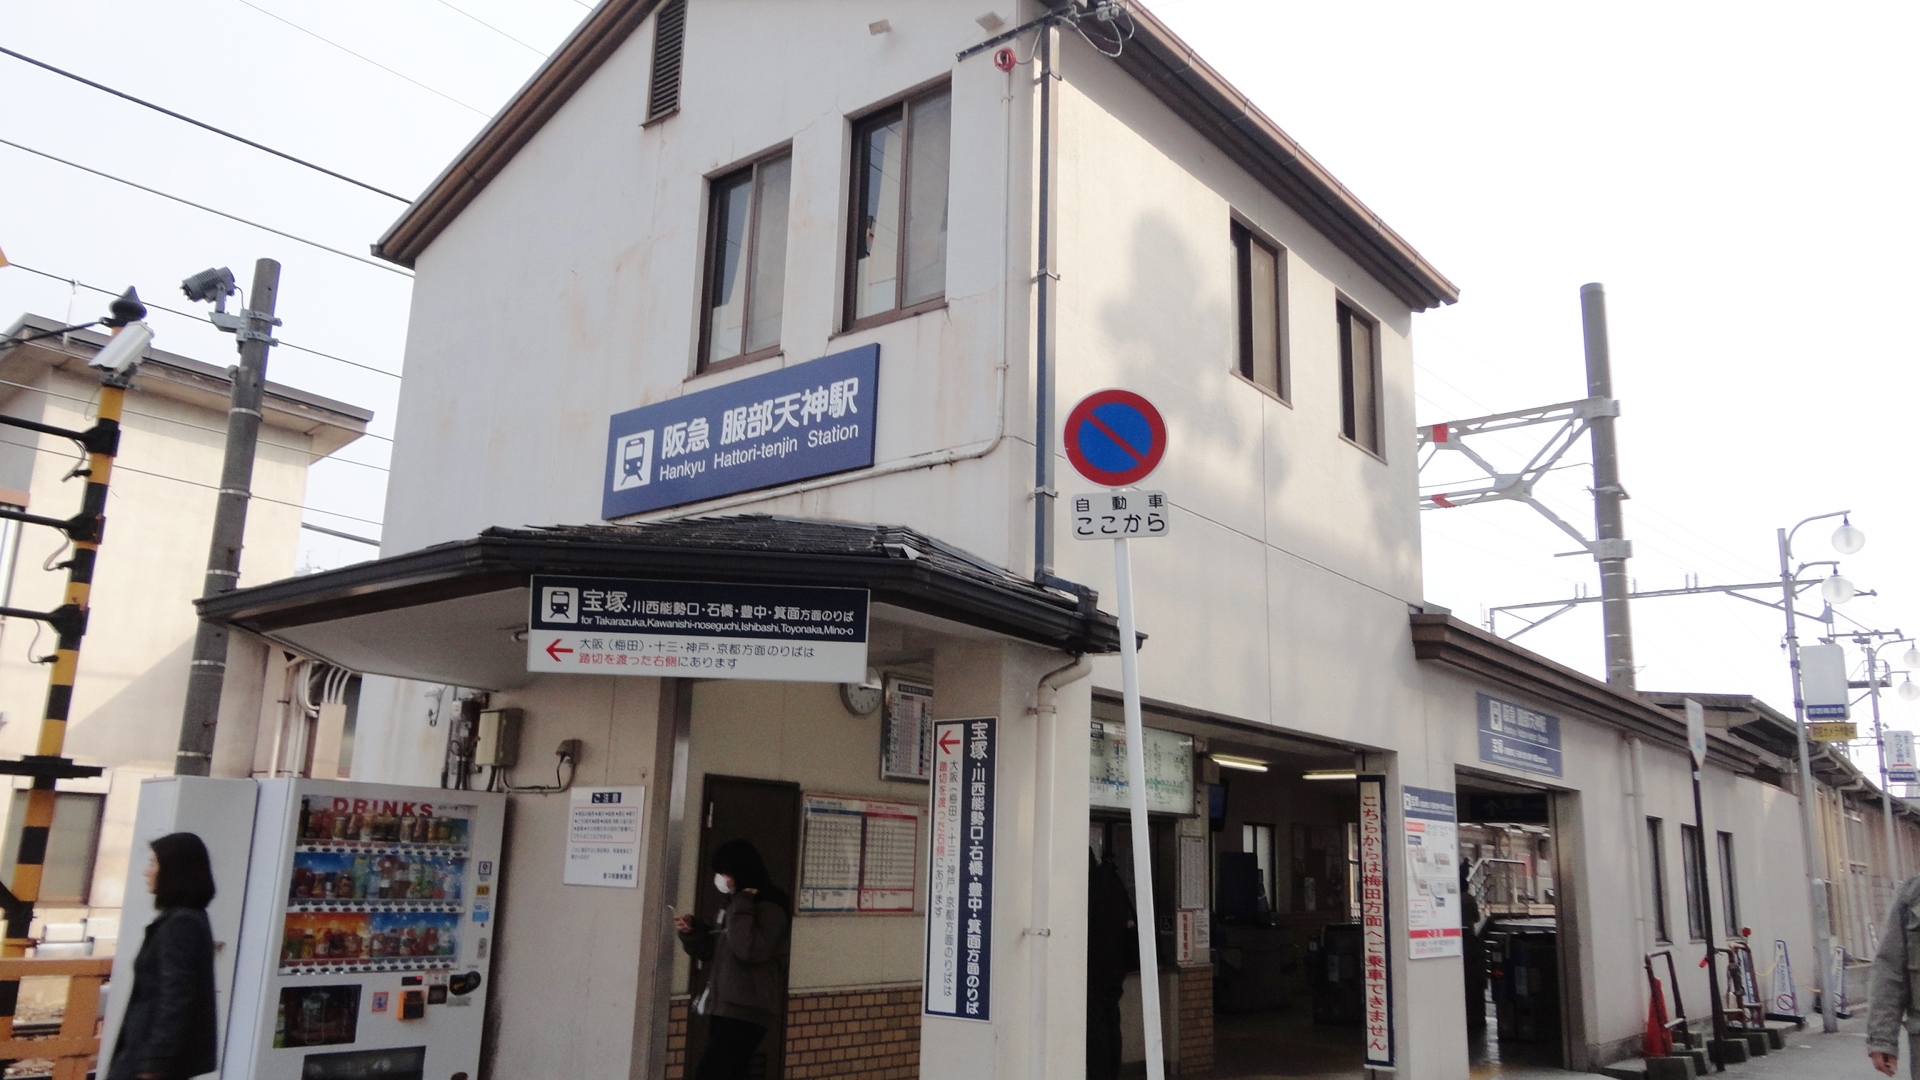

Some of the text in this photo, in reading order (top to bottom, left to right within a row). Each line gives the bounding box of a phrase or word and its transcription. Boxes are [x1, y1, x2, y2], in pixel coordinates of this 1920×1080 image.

[661, 377, 859, 460] 阪急 服部天神駅
[659, 423, 859, 482] Hankyu Hattori-tenjin Station
[1076, 494, 1163, 512] 自動車
[1077, 513, 1165, 535] ここから
[581, 615, 594, 625] for
[579, 652, 738, 670] 踏切を渡った右側にあります
[333, 797, 433, 817] DRINKS
[1362, 796, 1387, 1051] こちらからは梅田方面へご乗車できません
